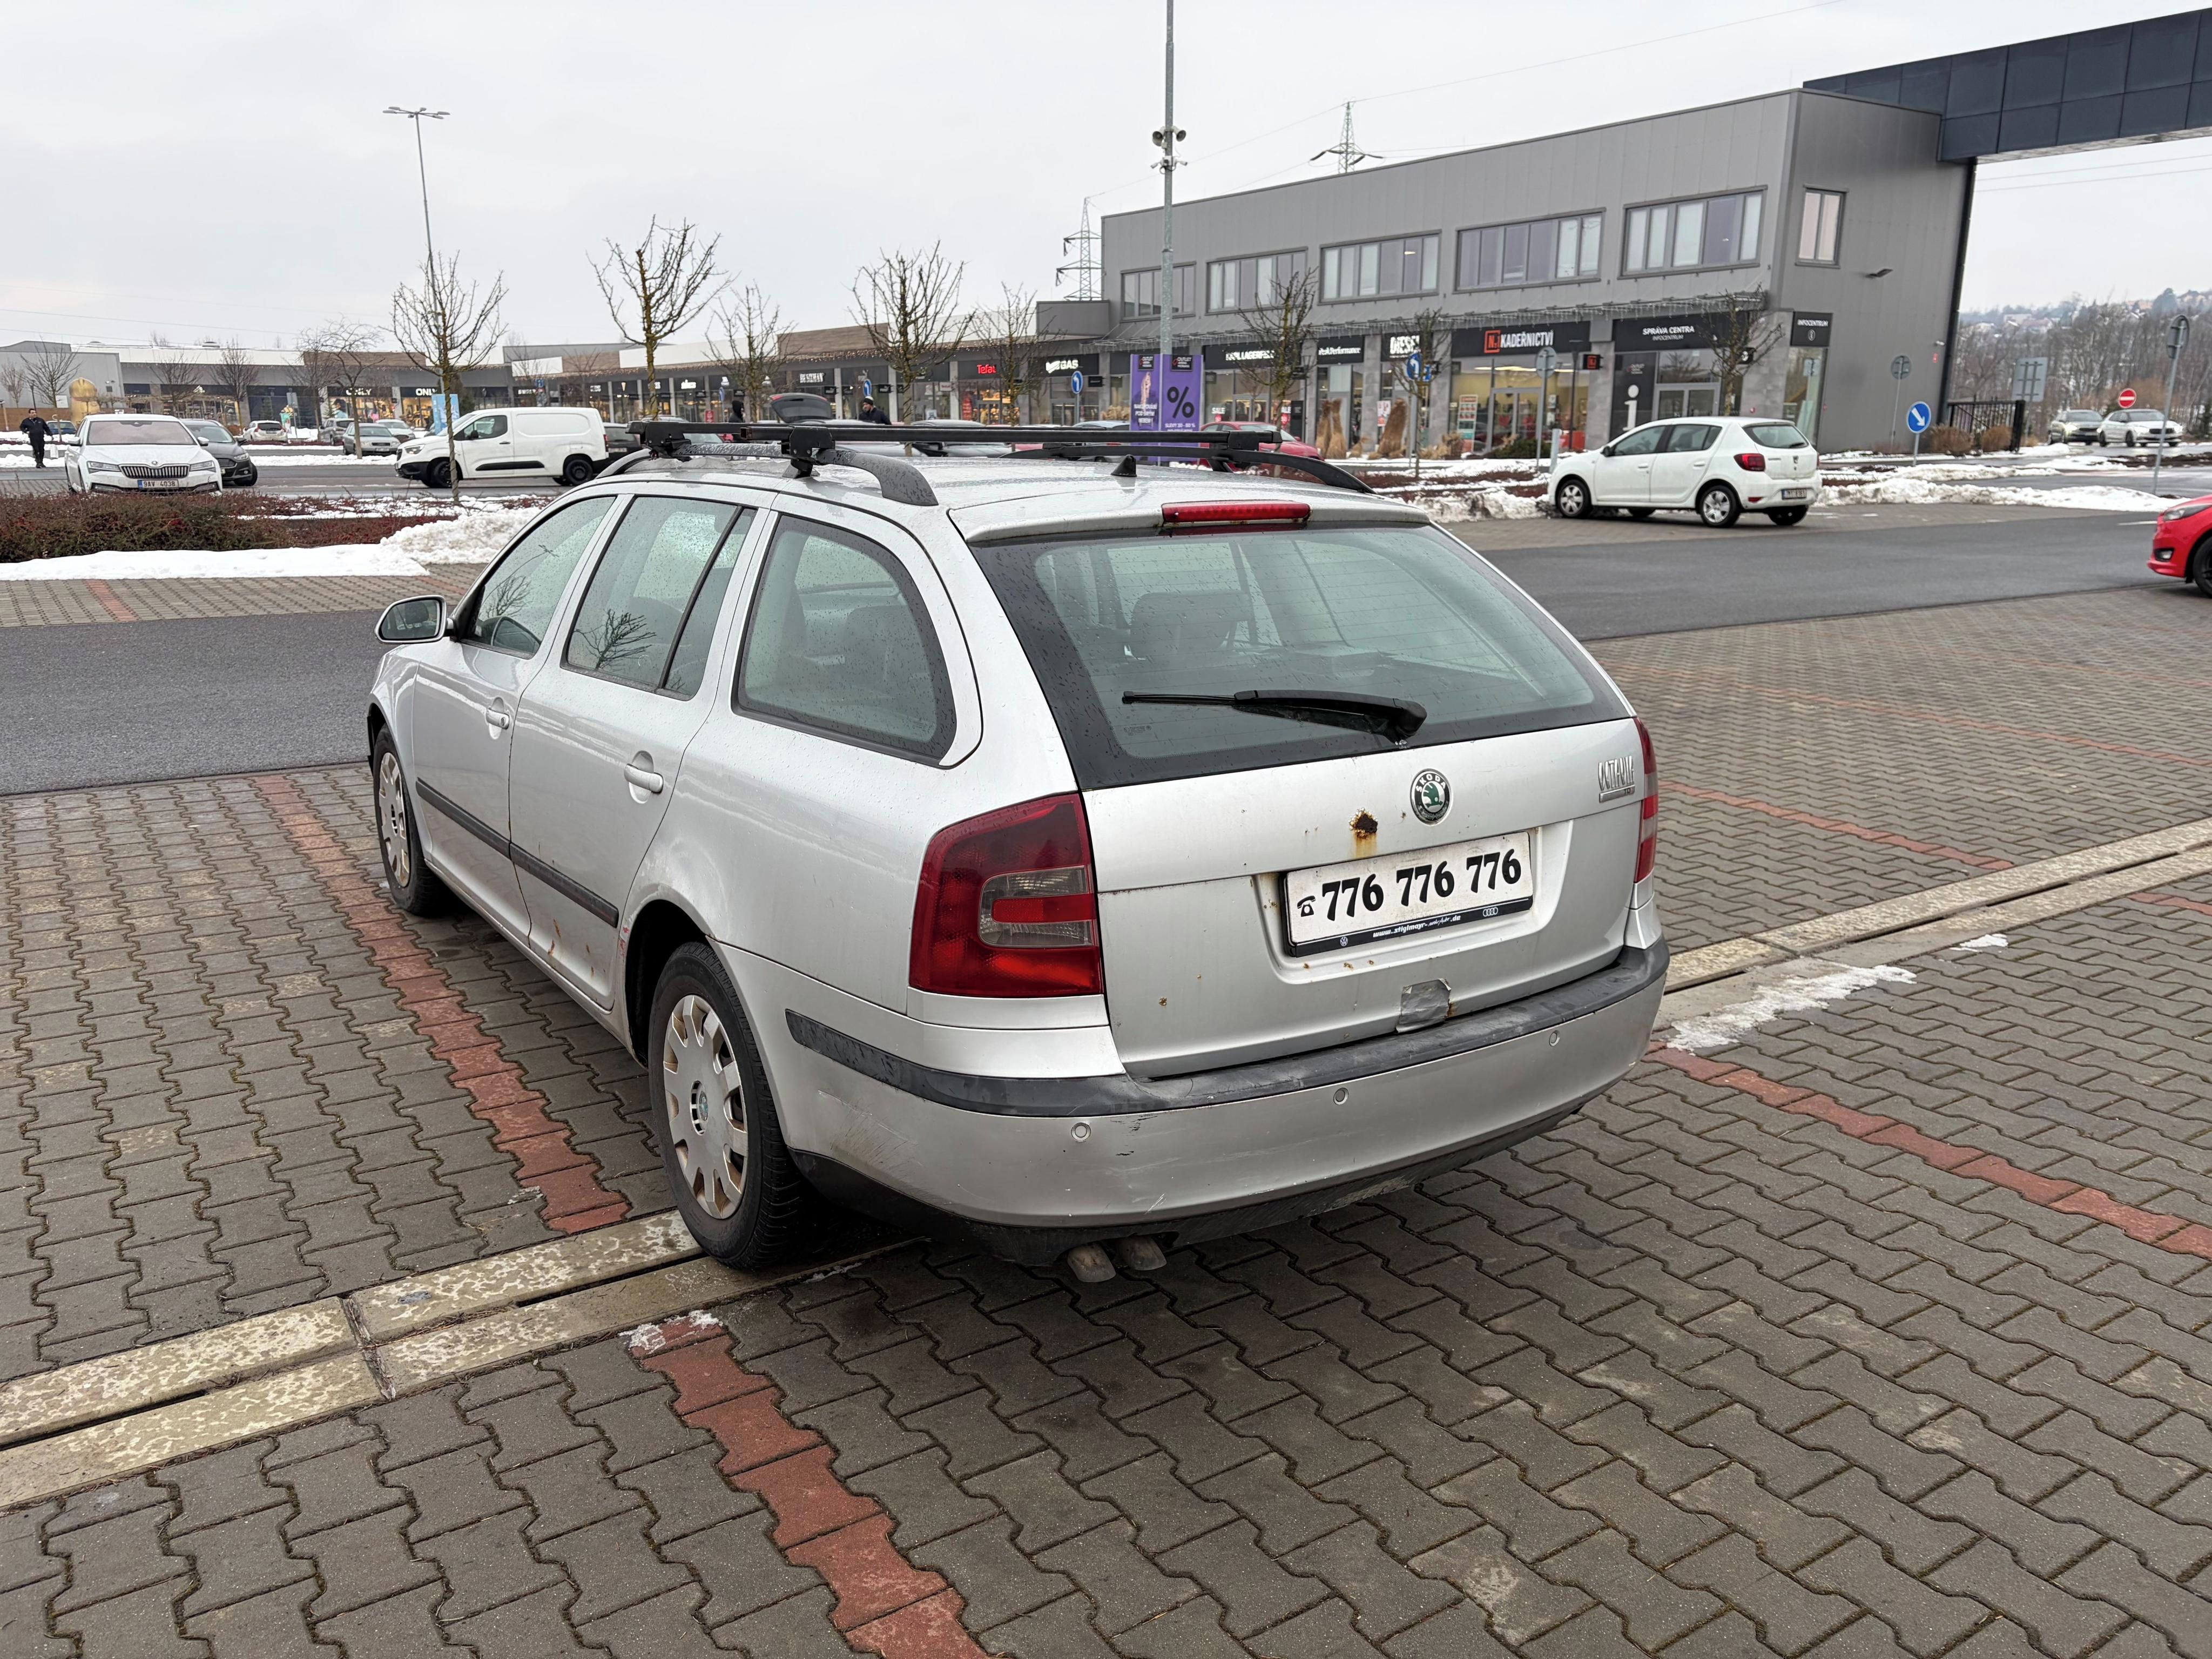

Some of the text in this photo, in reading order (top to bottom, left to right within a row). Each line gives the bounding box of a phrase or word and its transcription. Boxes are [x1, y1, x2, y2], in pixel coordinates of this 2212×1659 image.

[1642, 326, 1695, 335] SPRÁVA CENTRA
[1500, 330, 1554, 348] KADEŘNICTVÍ
[977, 364, 997, 374] Tefal
[1060, 359, 1079, 369] GAS
[1167, 386, 1195, 419] %
[1321, 848, 1522, 921] 776 776 776
